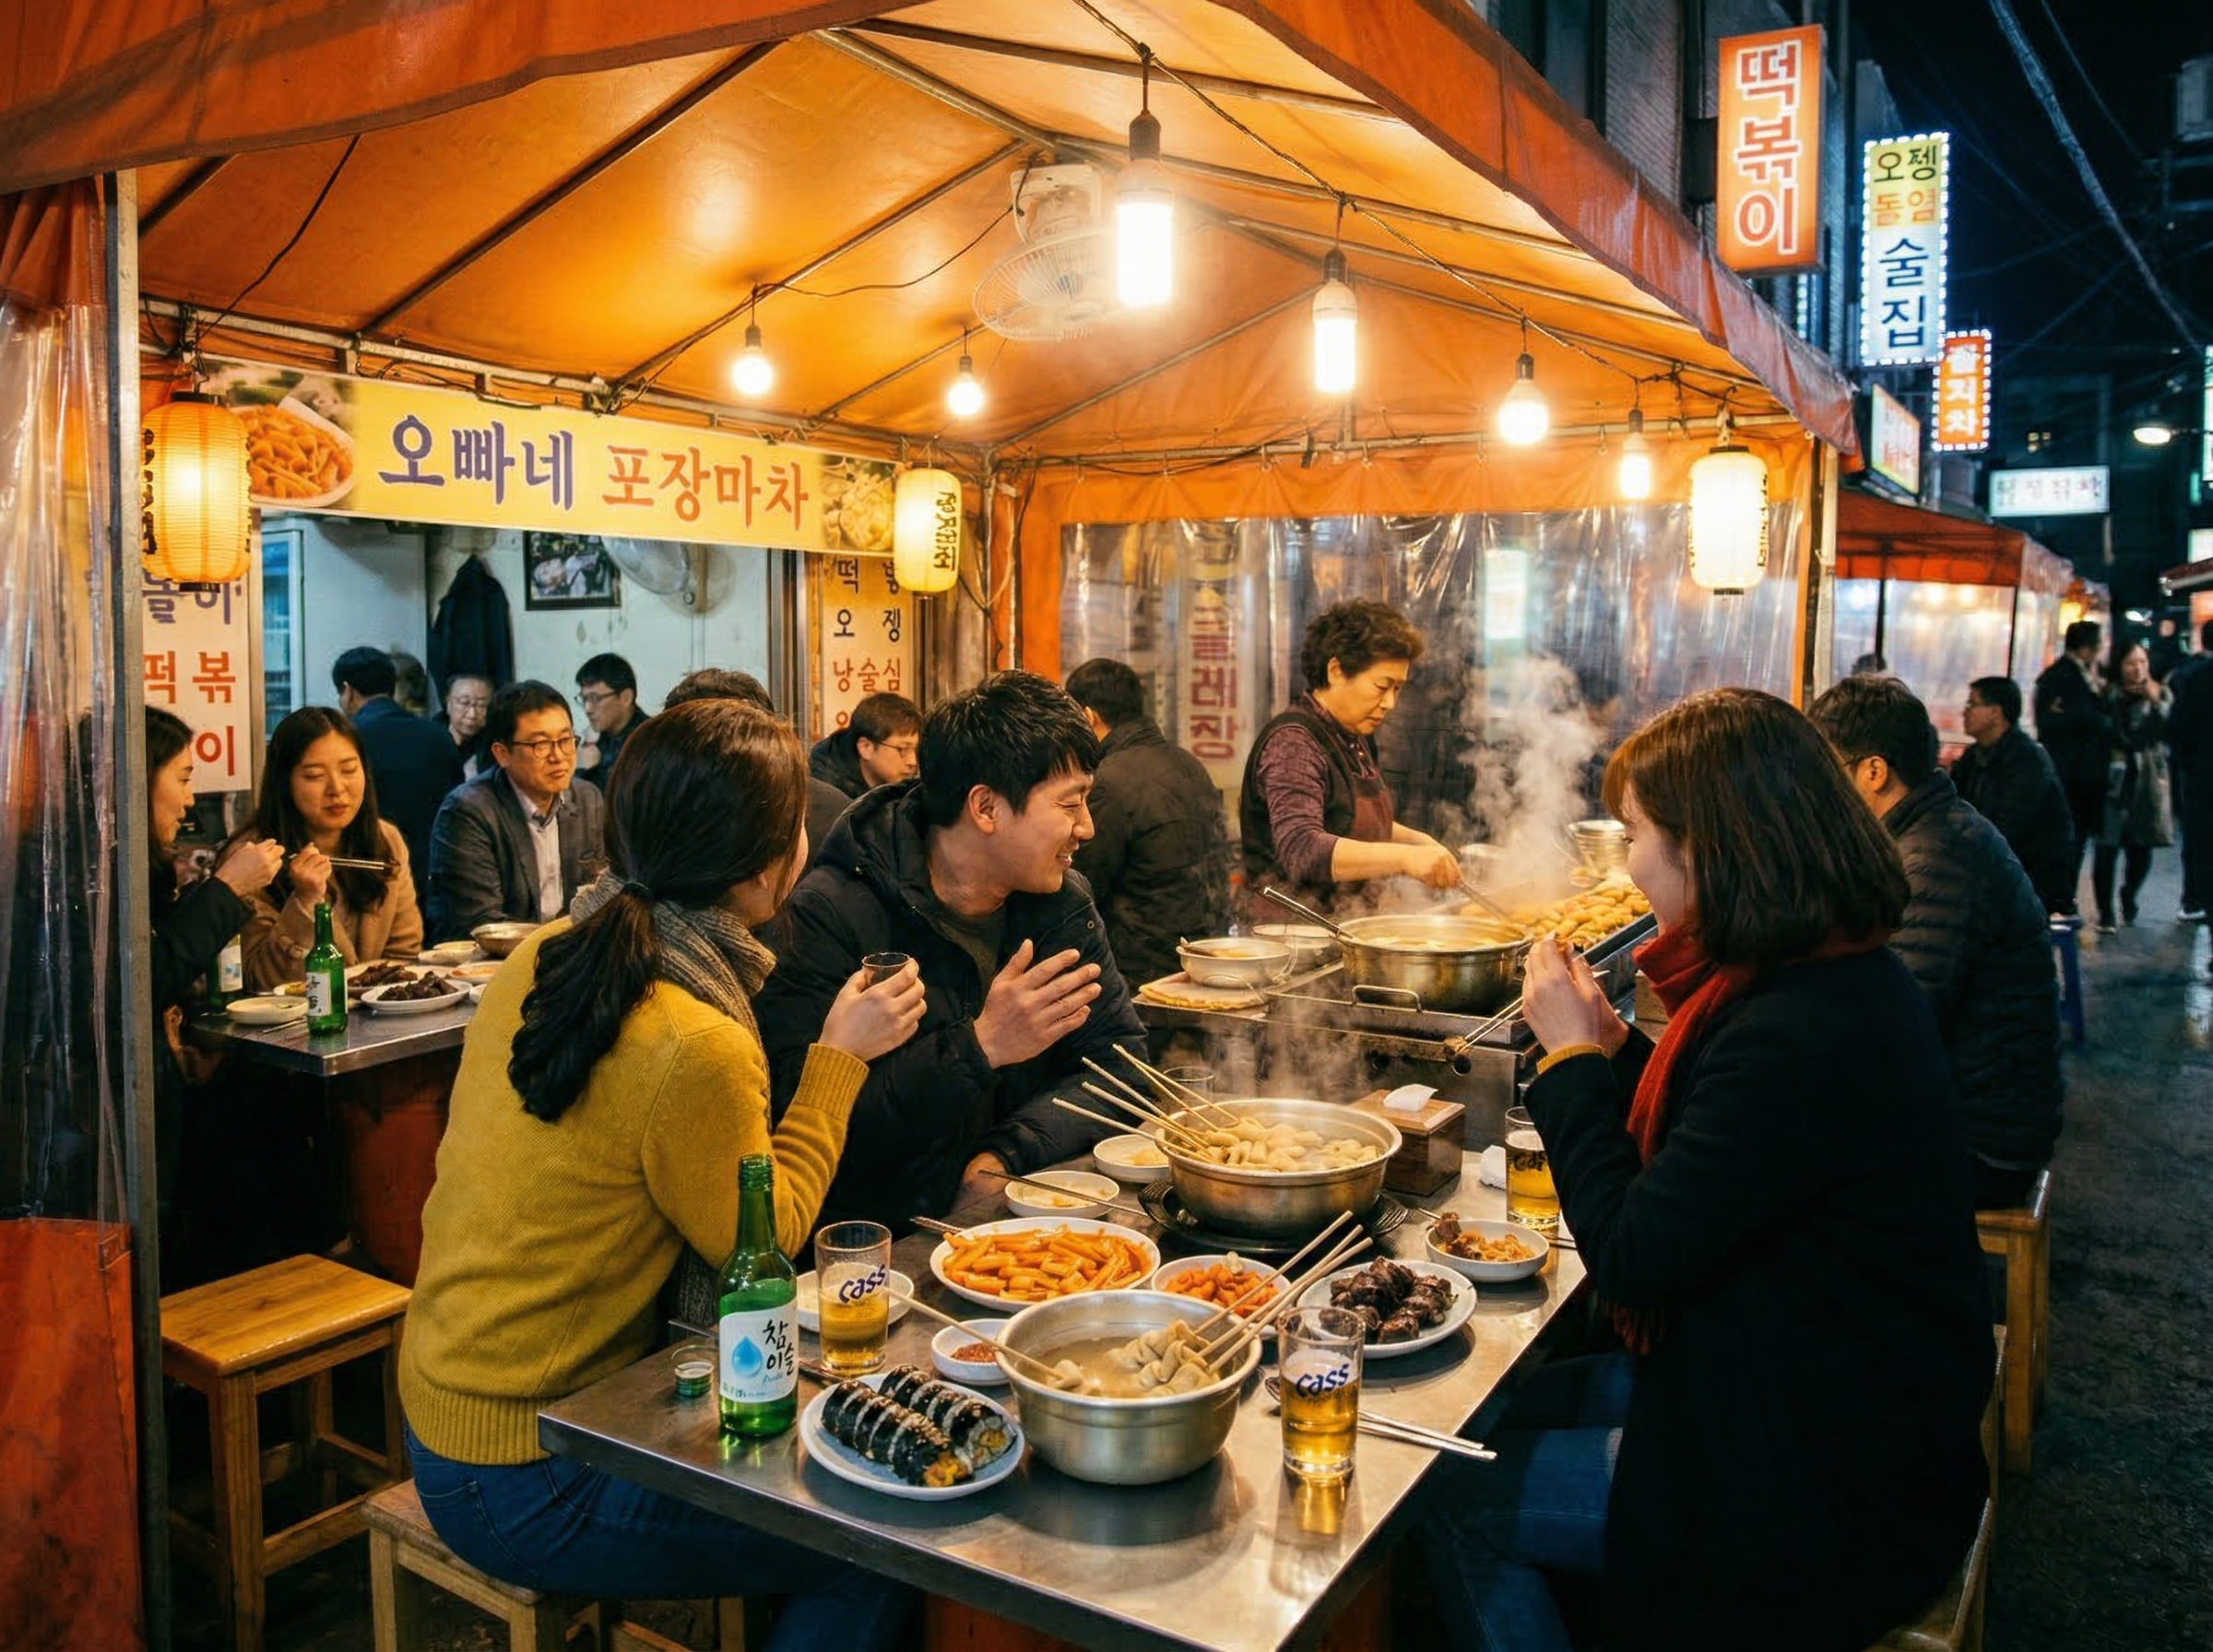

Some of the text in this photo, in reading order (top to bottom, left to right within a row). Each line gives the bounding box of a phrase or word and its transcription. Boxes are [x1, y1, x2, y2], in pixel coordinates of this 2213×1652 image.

[1735, 40, 1802, 254] 떡볶이
[1879, 238, 1929, 348] 술집
[378, 414, 810, 532] 오빠네 포장마차
